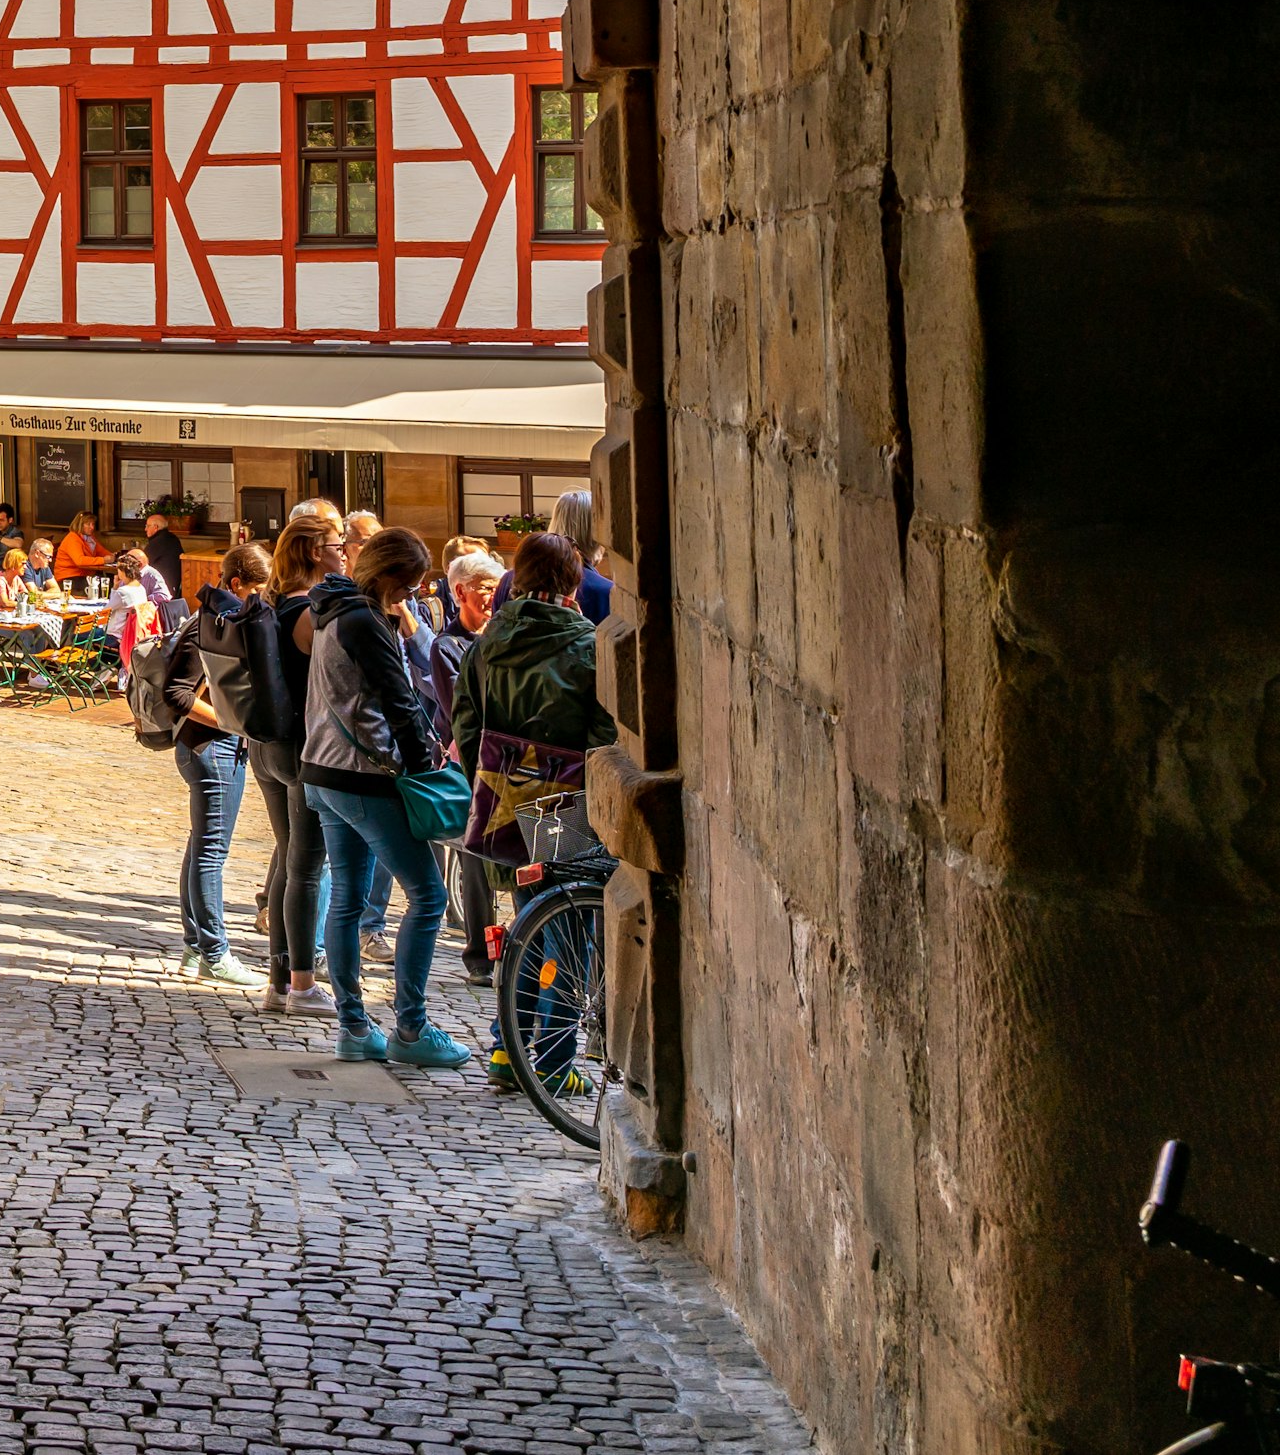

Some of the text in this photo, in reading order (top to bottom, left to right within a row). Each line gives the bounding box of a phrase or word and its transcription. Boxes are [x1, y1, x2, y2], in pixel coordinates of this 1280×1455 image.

[9, 413, 62, 430] Gasthaus
[65, 415, 86, 432] Zur
[89, 417, 142, 434] Schranke
